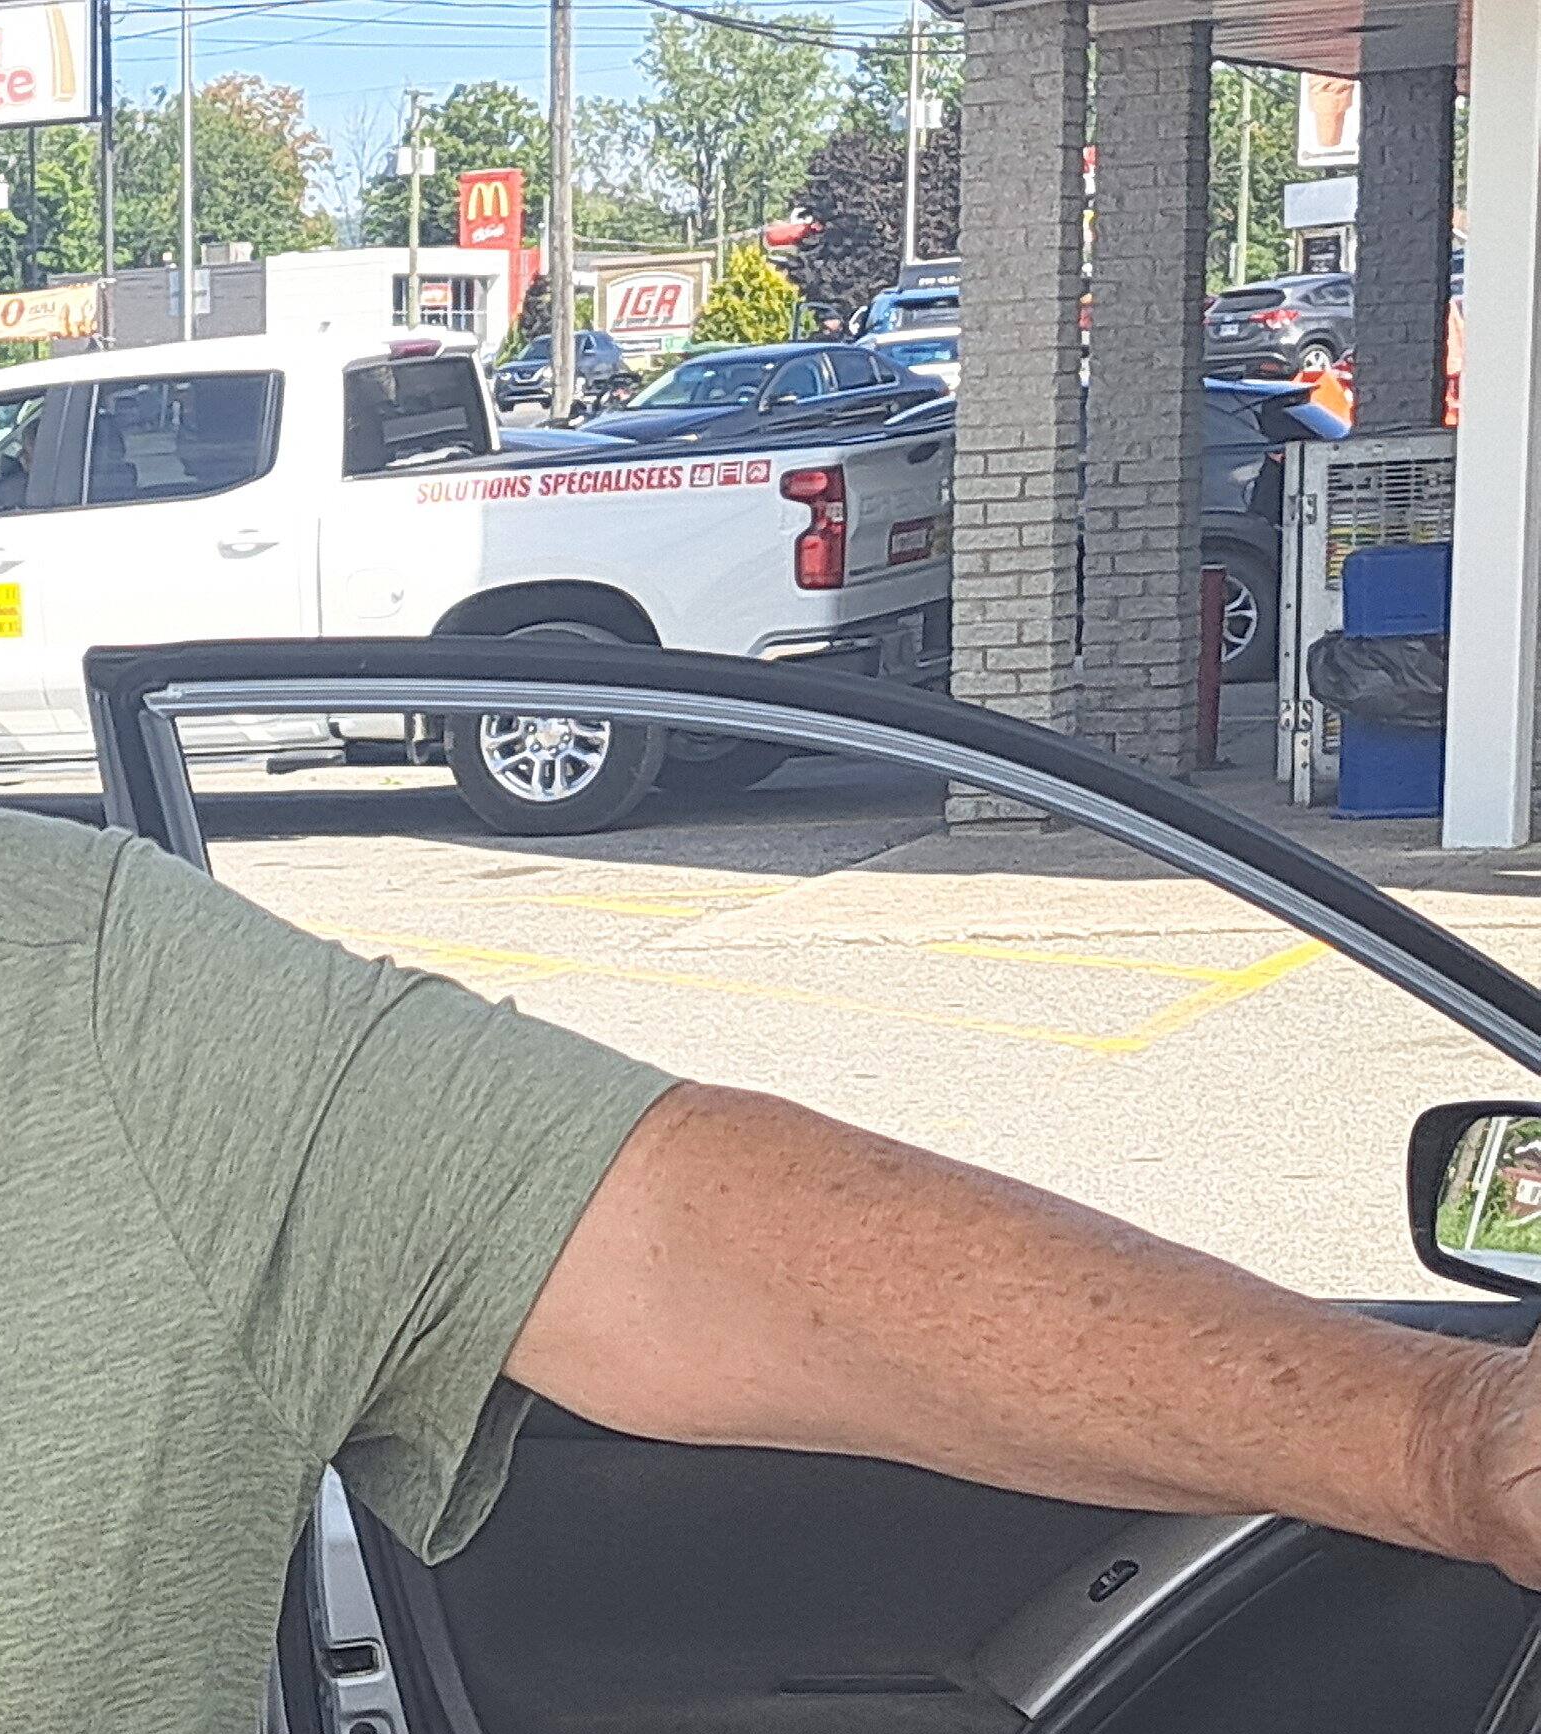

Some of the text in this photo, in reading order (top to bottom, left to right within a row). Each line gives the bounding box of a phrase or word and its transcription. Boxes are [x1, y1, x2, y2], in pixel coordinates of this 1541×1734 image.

[615, 284, 682, 321] IGA
[416, 464, 684, 504] SOLUTIONS SPÉCIALISÉES
